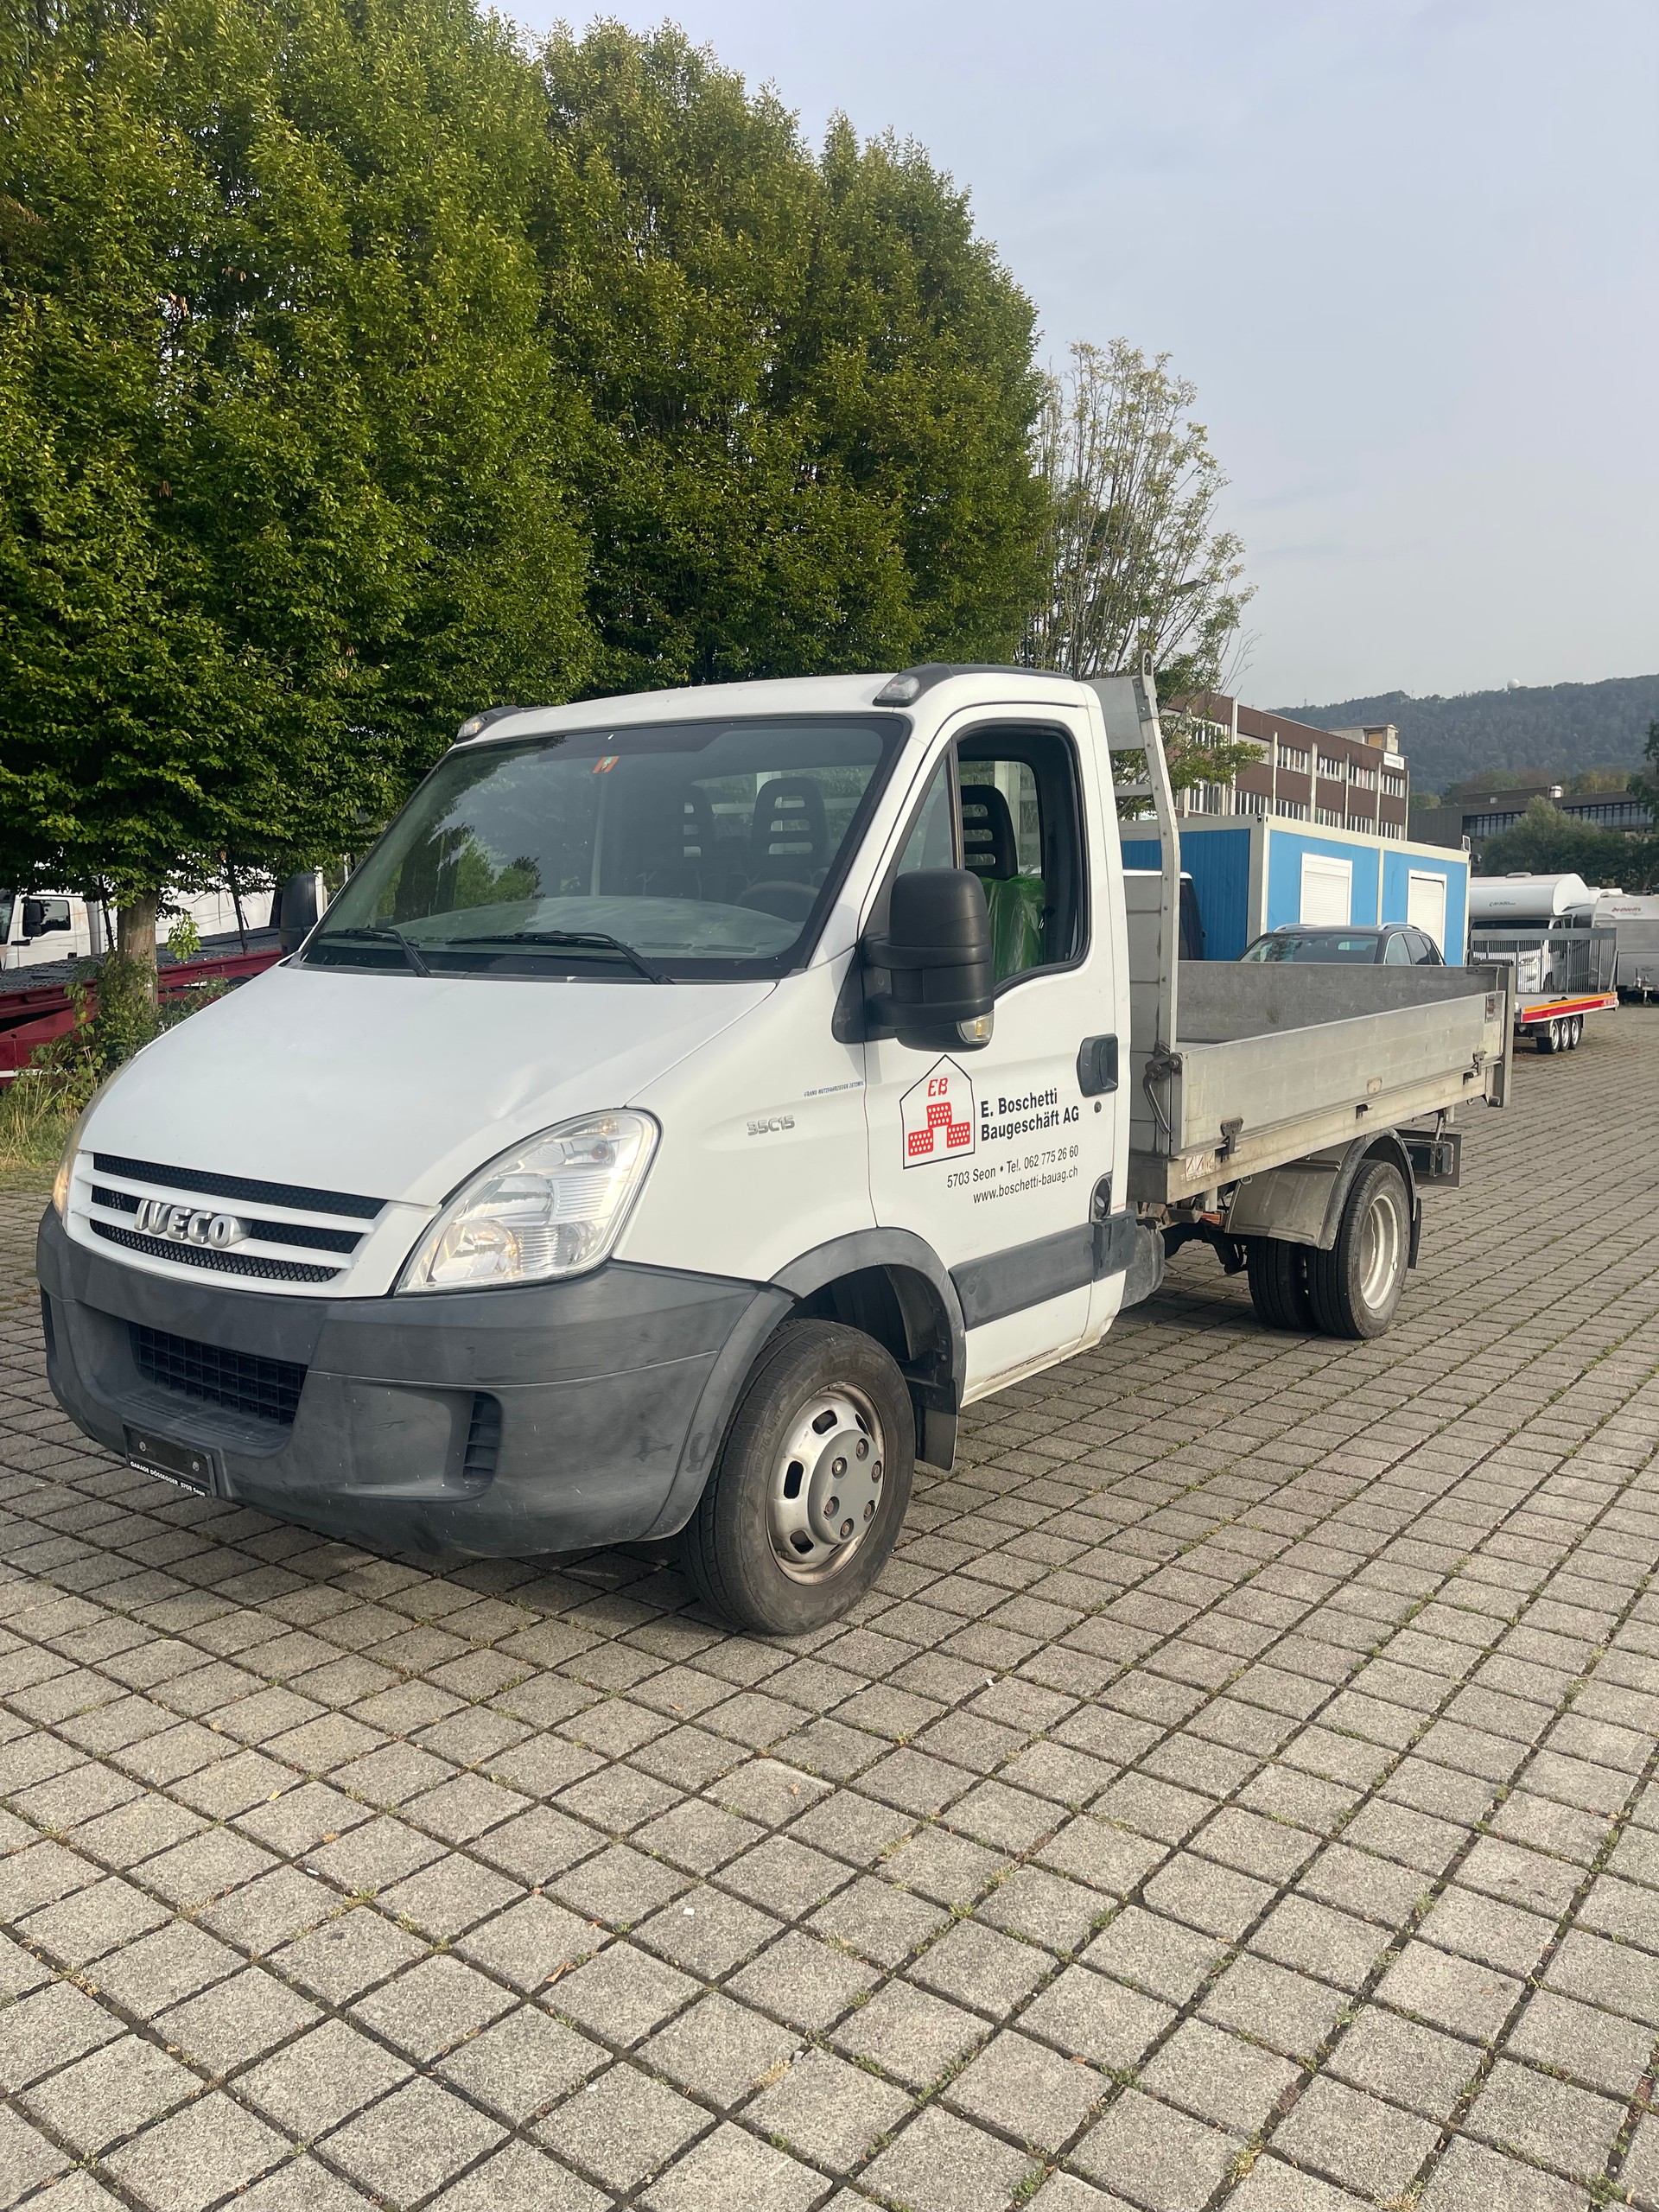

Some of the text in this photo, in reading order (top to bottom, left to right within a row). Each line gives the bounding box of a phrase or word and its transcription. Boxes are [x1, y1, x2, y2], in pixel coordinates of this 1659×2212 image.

[927, 1077, 949, 1097] EB
[980, 1087, 1058, 1119] E. Boschetti
[747, 1115, 796, 1136] 35C15
[981, 1105, 1079, 1141] Baugeschäft AG
[947, 1144, 1079, 1188] 5703 Seon Tel. 062 775 26 60
[973, 1165, 1078, 1204] www.boschetti-bauag.ch
[134, 1198, 243, 1249] IVECO
[130, 1461, 149, 1474] GARAGE
